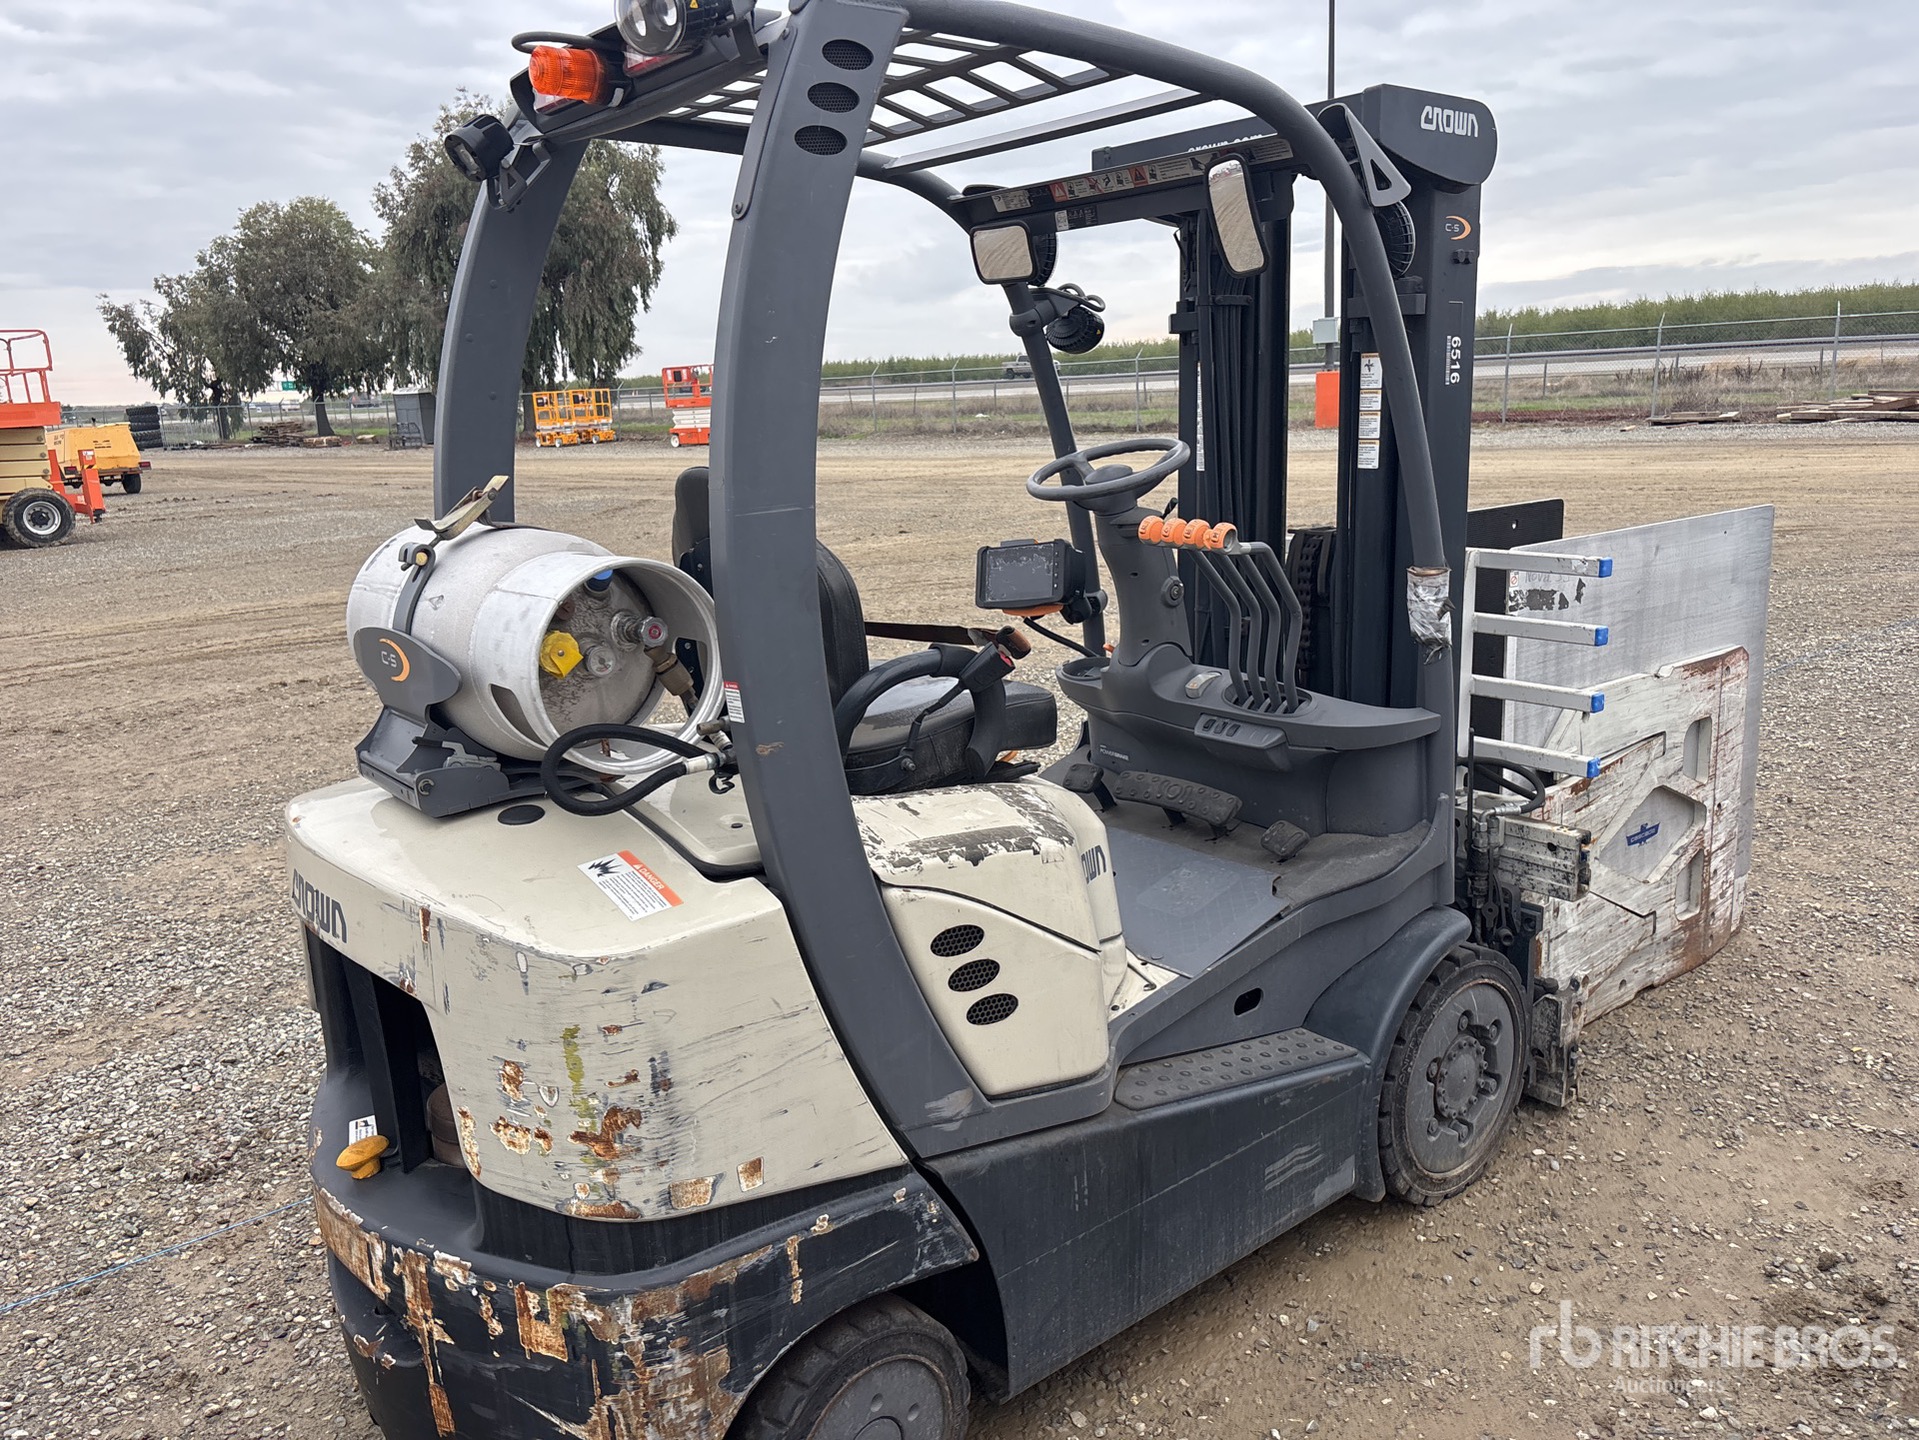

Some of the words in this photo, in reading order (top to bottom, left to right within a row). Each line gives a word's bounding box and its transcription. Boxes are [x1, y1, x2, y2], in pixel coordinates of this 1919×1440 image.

[1420, 105, 1479, 138] CROWN
[1450, 336, 1461, 384] 6516
[639, 867, 666, 890] DANGER
[292, 868, 348, 944] CROWN
